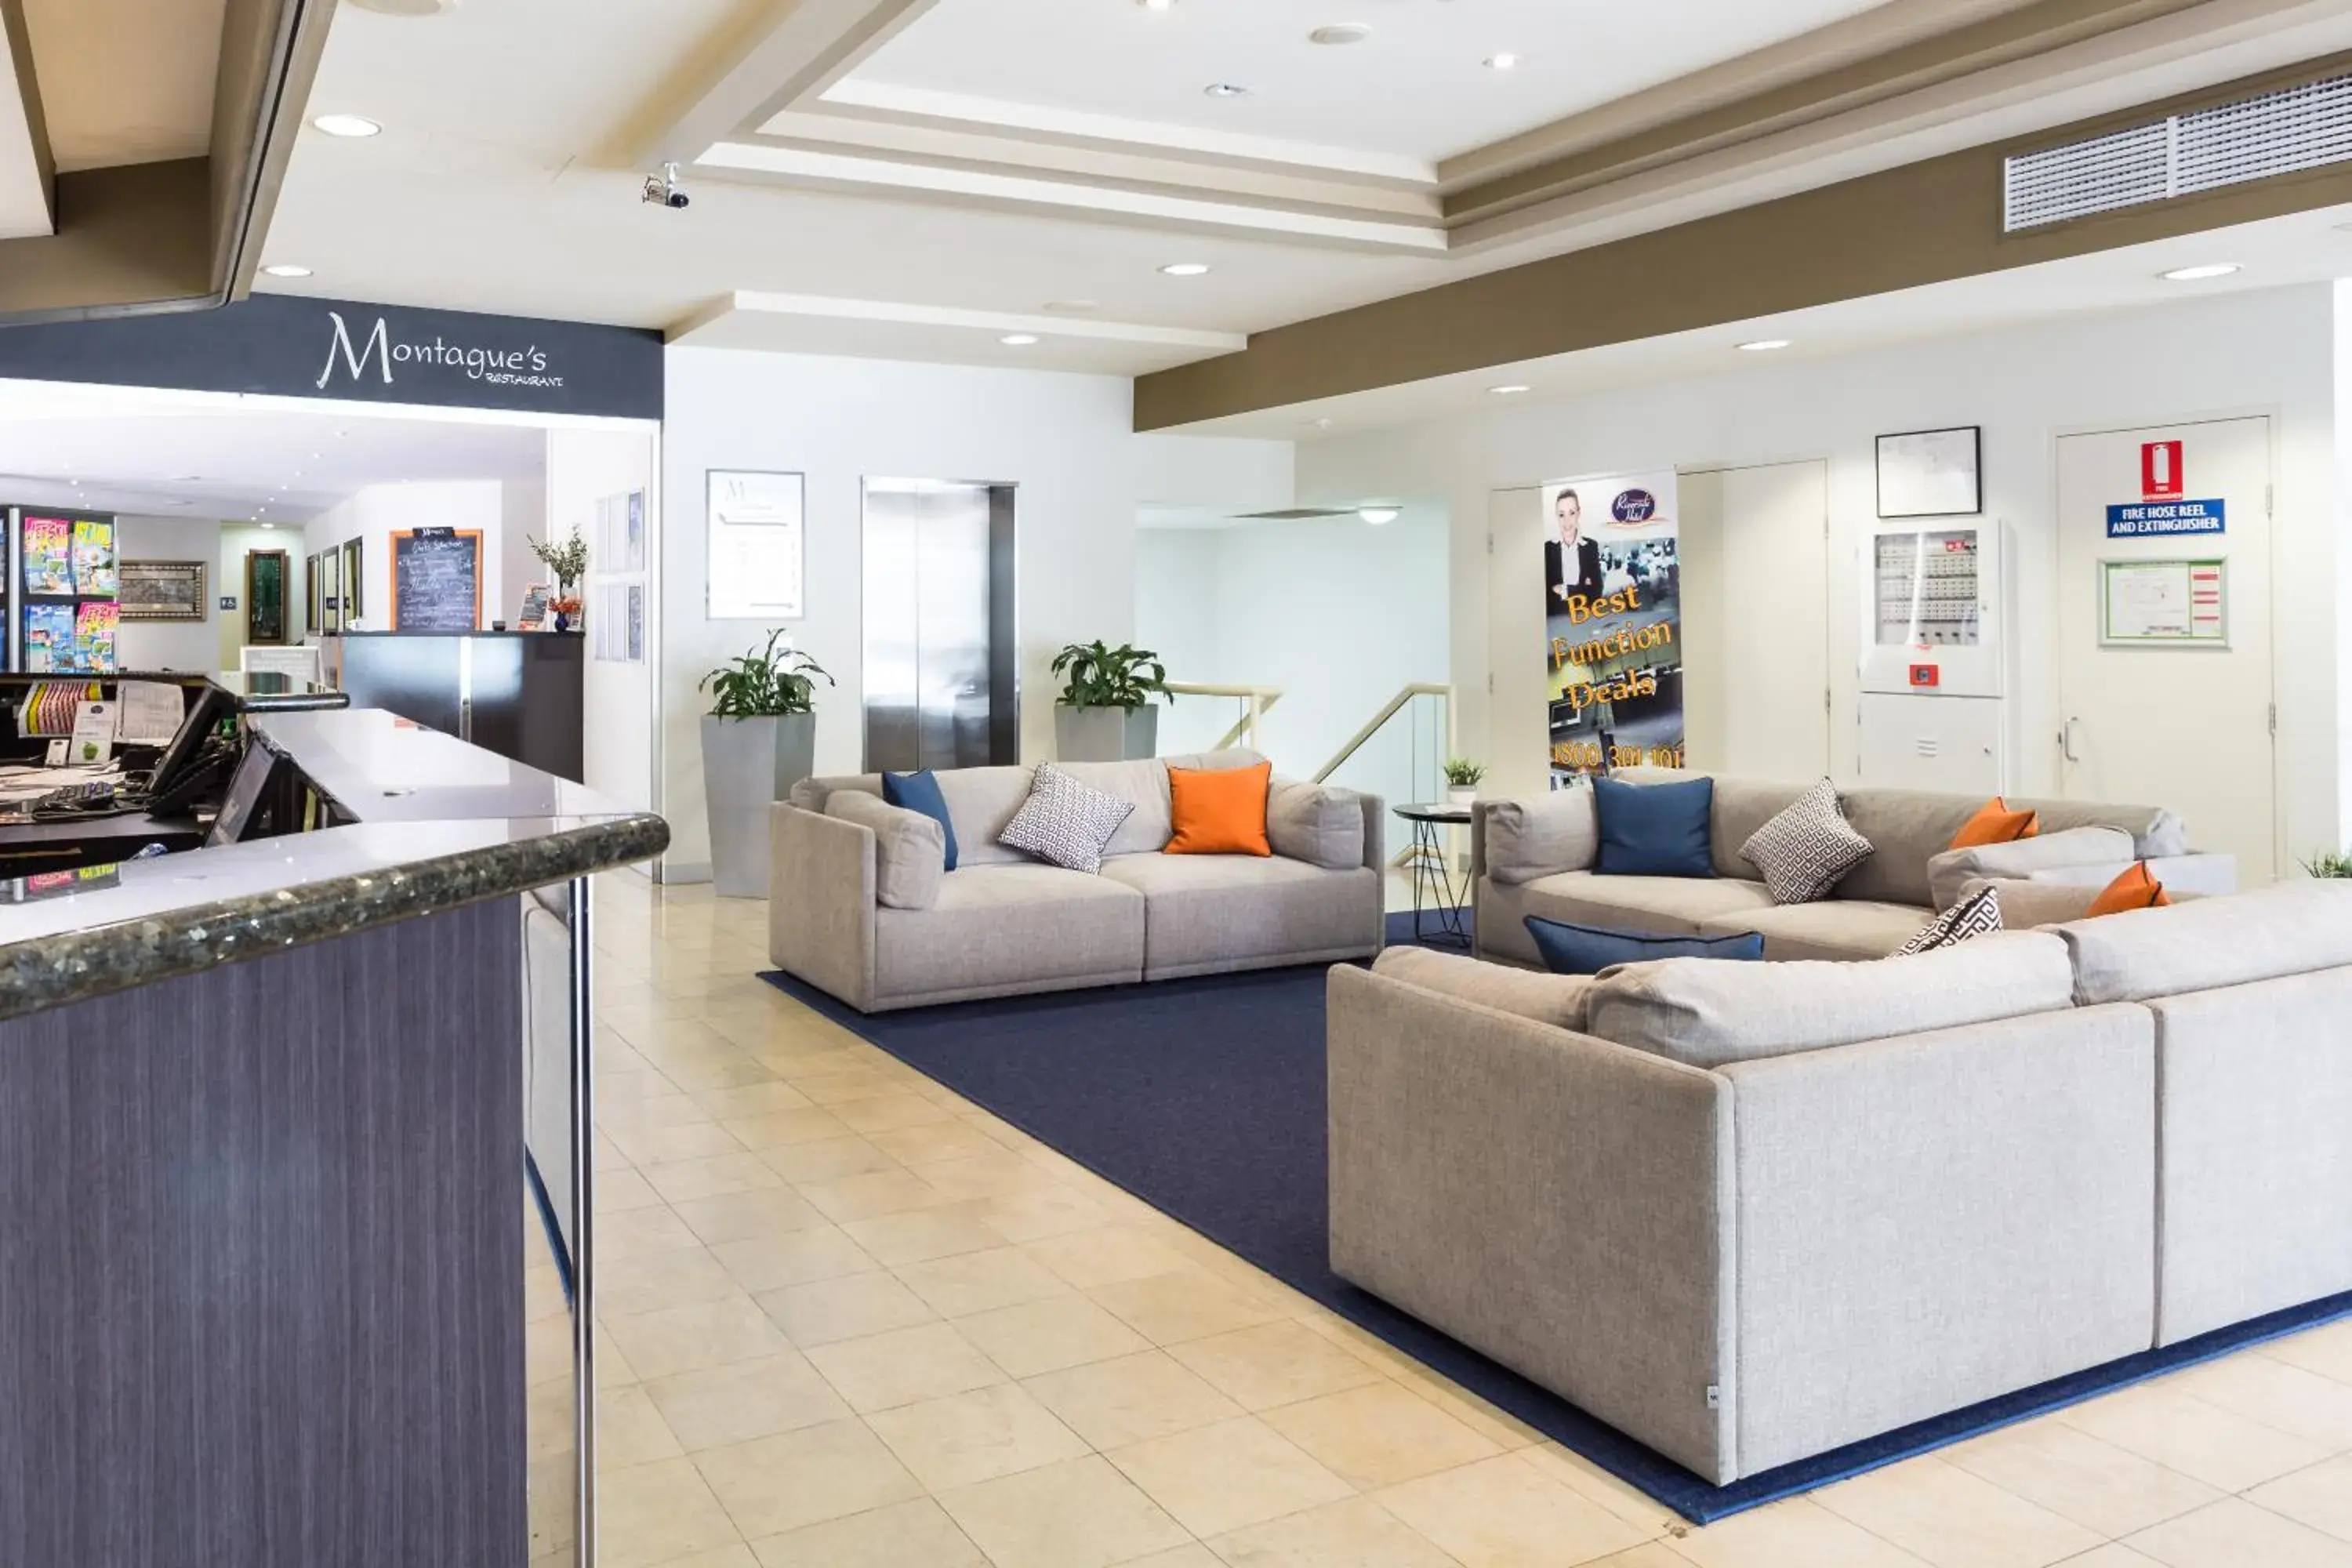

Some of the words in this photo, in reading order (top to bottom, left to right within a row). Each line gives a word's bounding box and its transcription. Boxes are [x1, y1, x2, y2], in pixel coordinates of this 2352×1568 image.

[316, 311, 548, 390] Montague's
[485, 372, 564, 387] RESTAURANT
[2112, 522, 2136, 534] AND
[2138, 517, 2220, 532] EXTINGUISHER
[2122, 508, 2145, 520] FIRE
[2147, 506, 2177, 518] HOSE
[2179, 504, 2208, 517] REEL
[1567, 584, 1642, 625] Best
[1551, 620, 1672, 672] Function
[1567, 666, 1657, 710] Deals
